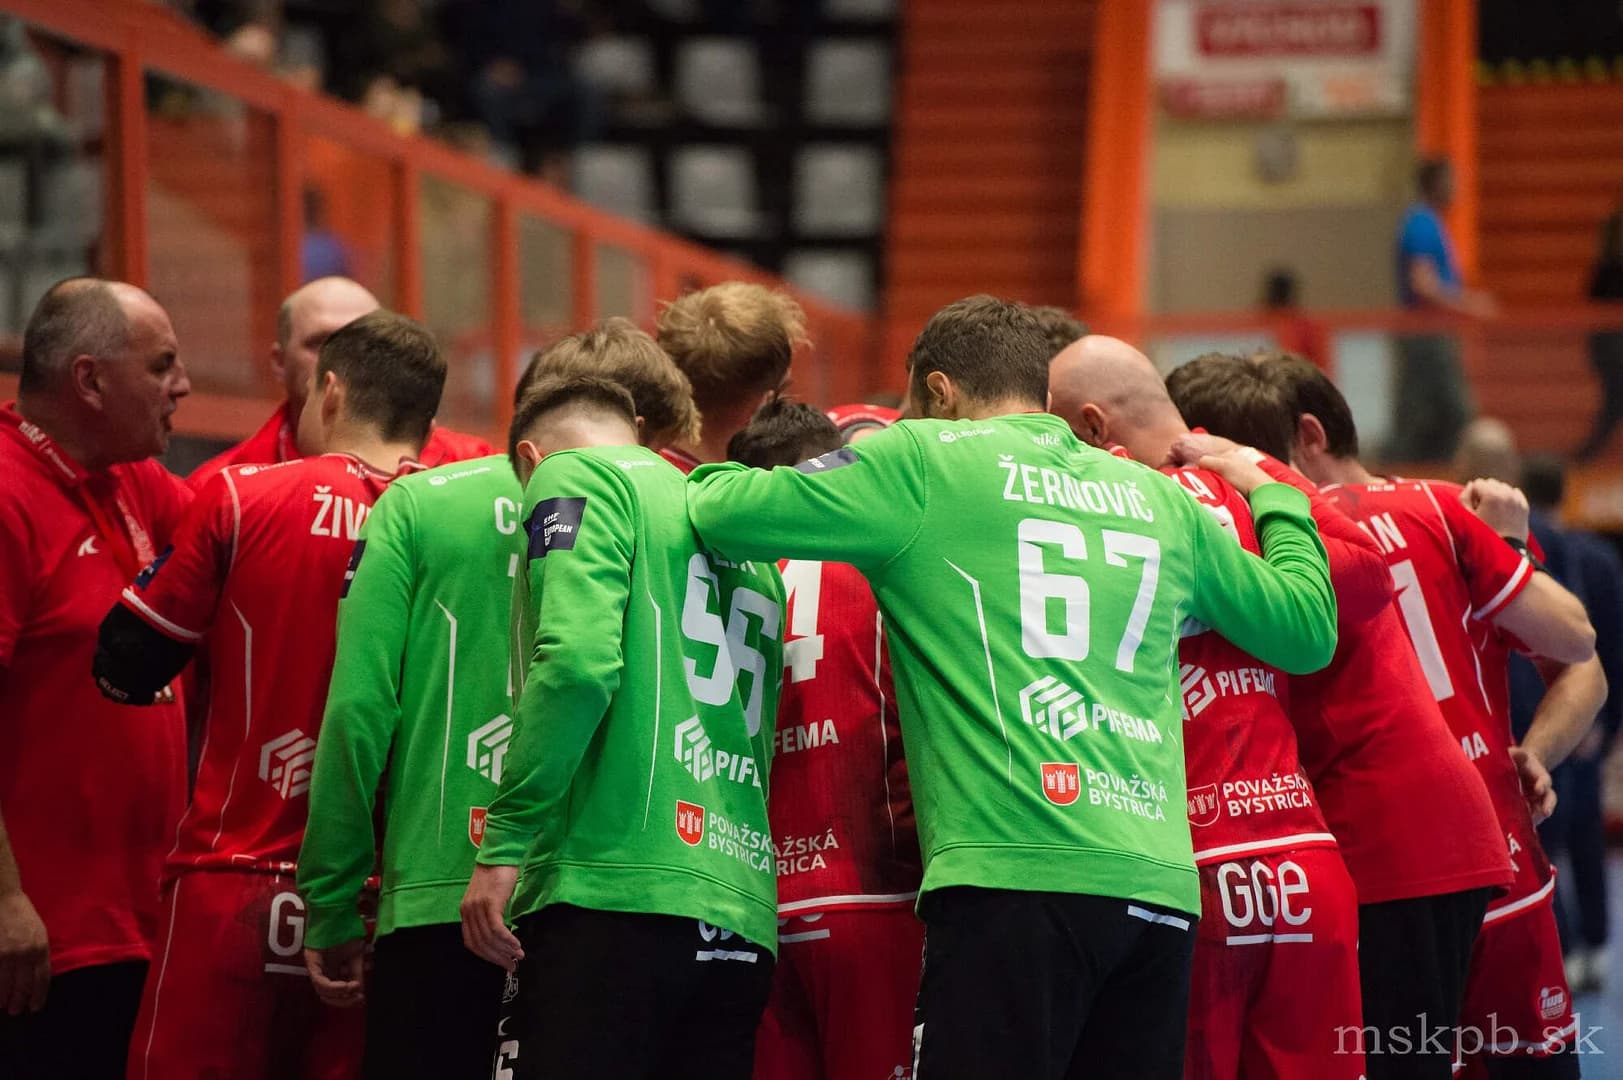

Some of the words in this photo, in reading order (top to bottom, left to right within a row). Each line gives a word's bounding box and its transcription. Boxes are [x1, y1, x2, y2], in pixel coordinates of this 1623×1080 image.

[997, 453, 1153, 523] ŽERNOVIČ
[310, 485, 371, 541] ŽIV
[1017, 518, 1161, 673] 67
[781, 559, 824, 683] 4
[1092, 703, 1163, 745] PIFEMA
[1085, 767, 1169, 804] POVAŽSKÁ
[1088, 787, 1167, 822] BYSTRICA
[1226, 791, 1313, 818] BYSTRICA
[708, 812, 773, 854] POVAŽSK
[708, 832, 771, 874] BYSTRICA
